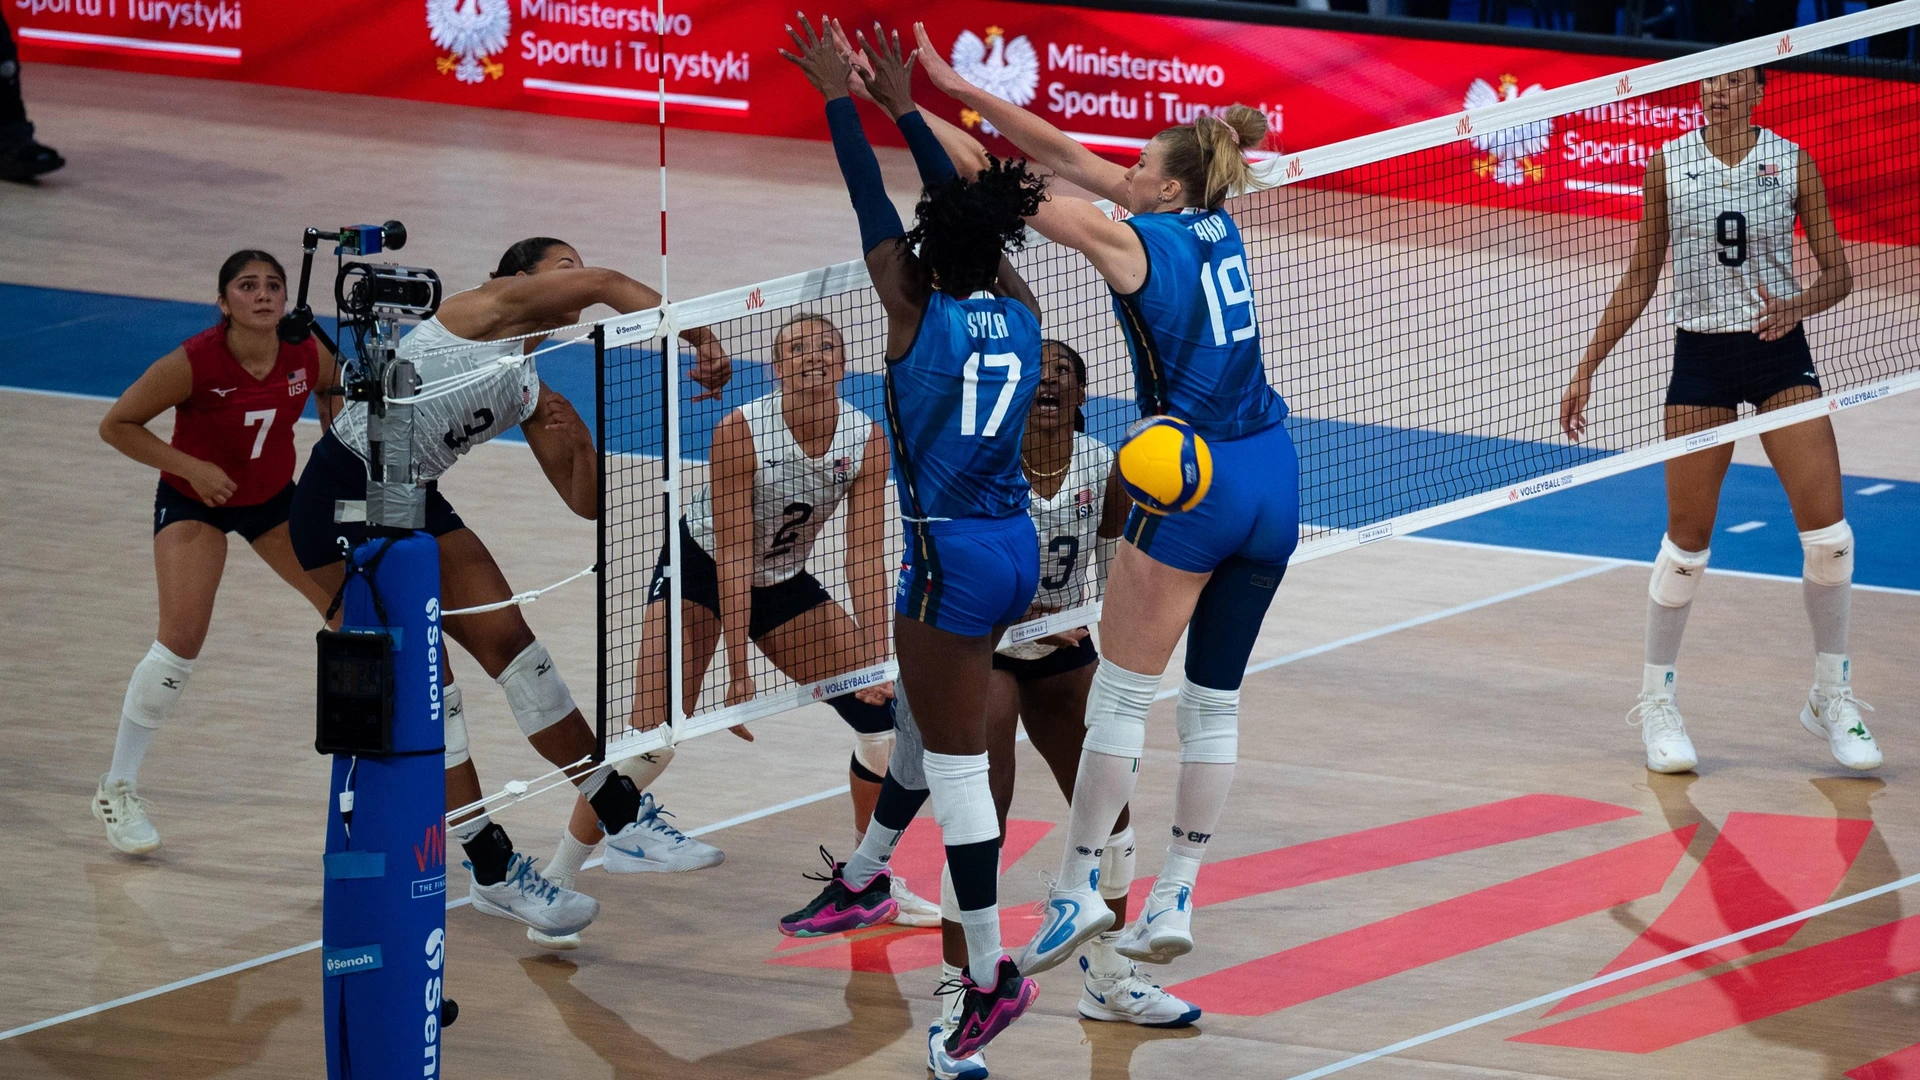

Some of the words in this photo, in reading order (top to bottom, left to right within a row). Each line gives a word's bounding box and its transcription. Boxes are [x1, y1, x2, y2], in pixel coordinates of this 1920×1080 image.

[520, 0, 692, 36] Ministerstwo
[520, 31, 607, 68] Sportu
[614, 40, 622, 69] i
[628, 41, 749, 84] Turystyki
[1047, 42, 1225, 88] Ministerstwo
[1048, 81, 1138, 120] Sportu
[1145, 91, 1153, 121] i
[1286, 157, 1304, 179] VNL
[1757, 176, 1780, 188] USA
[1717, 211, 1747, 267] 9
[745, 288, 765, 311] VNL
[1201, 254, 1256, 346] 19
[621, 323, 642, 334] Senoh
[967, 311, 1009, 339] SYLA
[288, 381, 308, 397] USA
[961, 352, 1022, 436] 17
[1839, 390, 1878, 407] VOLLEYBALL
[244, 408, 277, 460] 7
[444, 408, 494, 450] 3
[1520, 478, 1561, 497] VOLLEYBALL
[771, 502, 813, 549] 2
[653, 577, 664, 596] 2
[427, 625, 440, 720] Senoh
[825, 674, 871, 694] VOLLEYBALL
[413, 814, 446, 872] VN
[419, 883, 432, 893] THE
[334, 954, 373, 970] Senoh
[424, 976, 441, 1080] Sen
